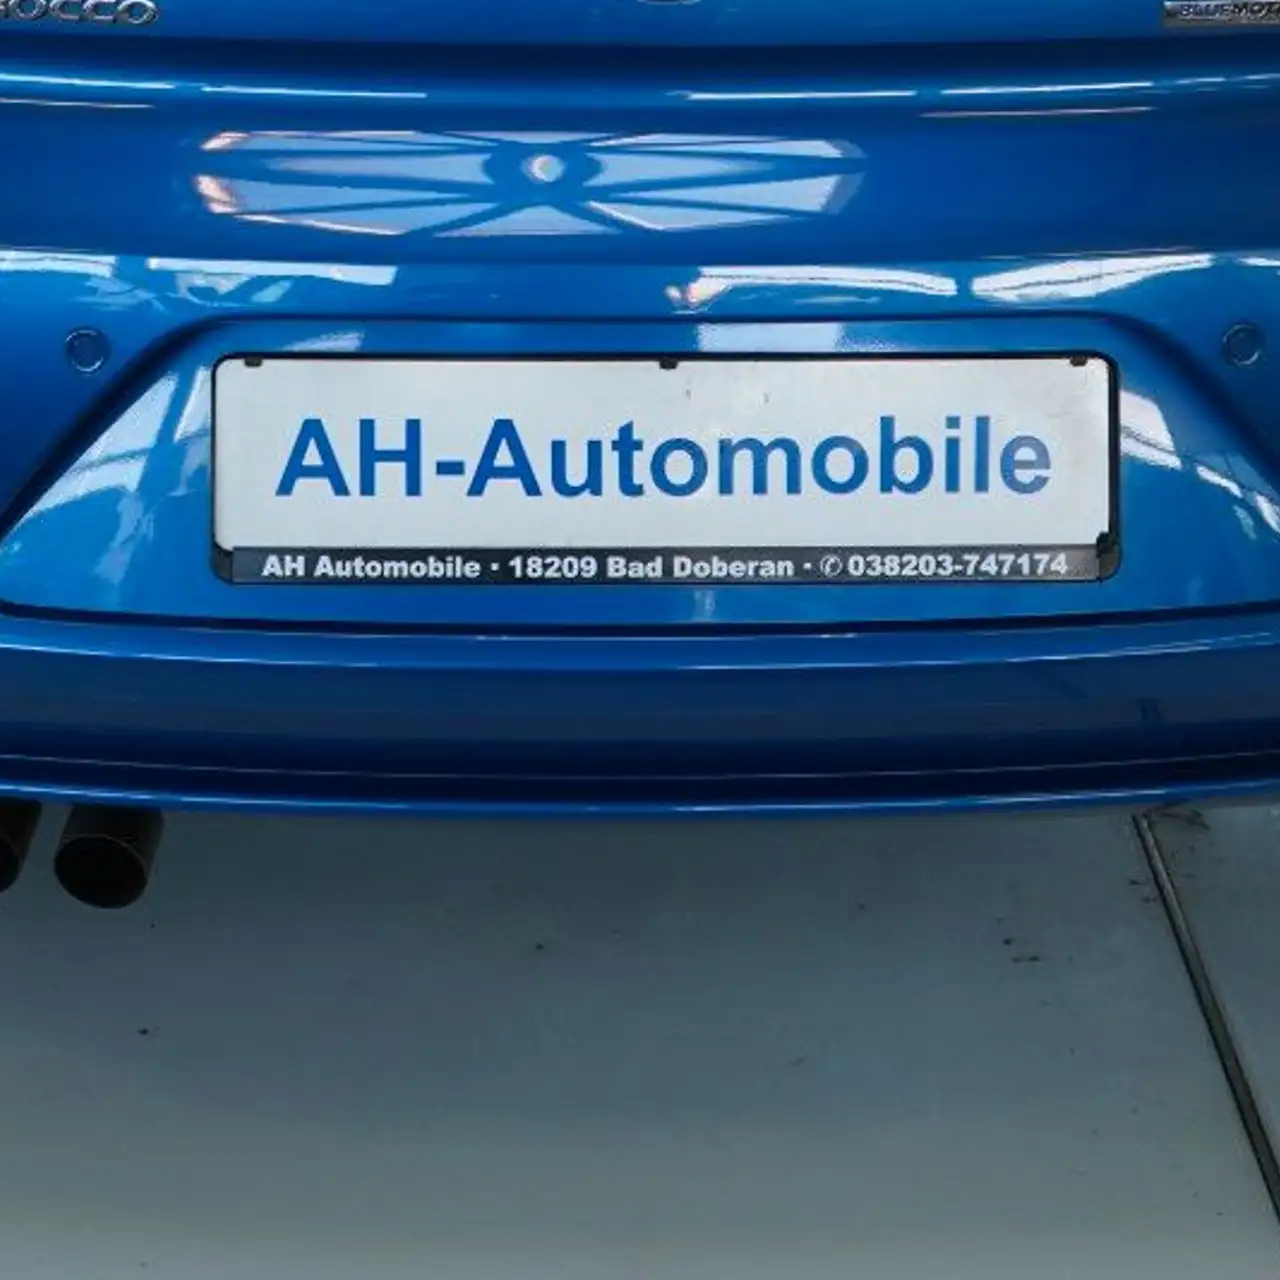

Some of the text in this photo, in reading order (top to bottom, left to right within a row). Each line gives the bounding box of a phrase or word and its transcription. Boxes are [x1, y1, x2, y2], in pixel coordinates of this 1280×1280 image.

[275, 415, 1052, 497] AH-Automobile
[261, 552, 1068, 578] AH Automobile 18209 Bad Doberan 038203-747174
